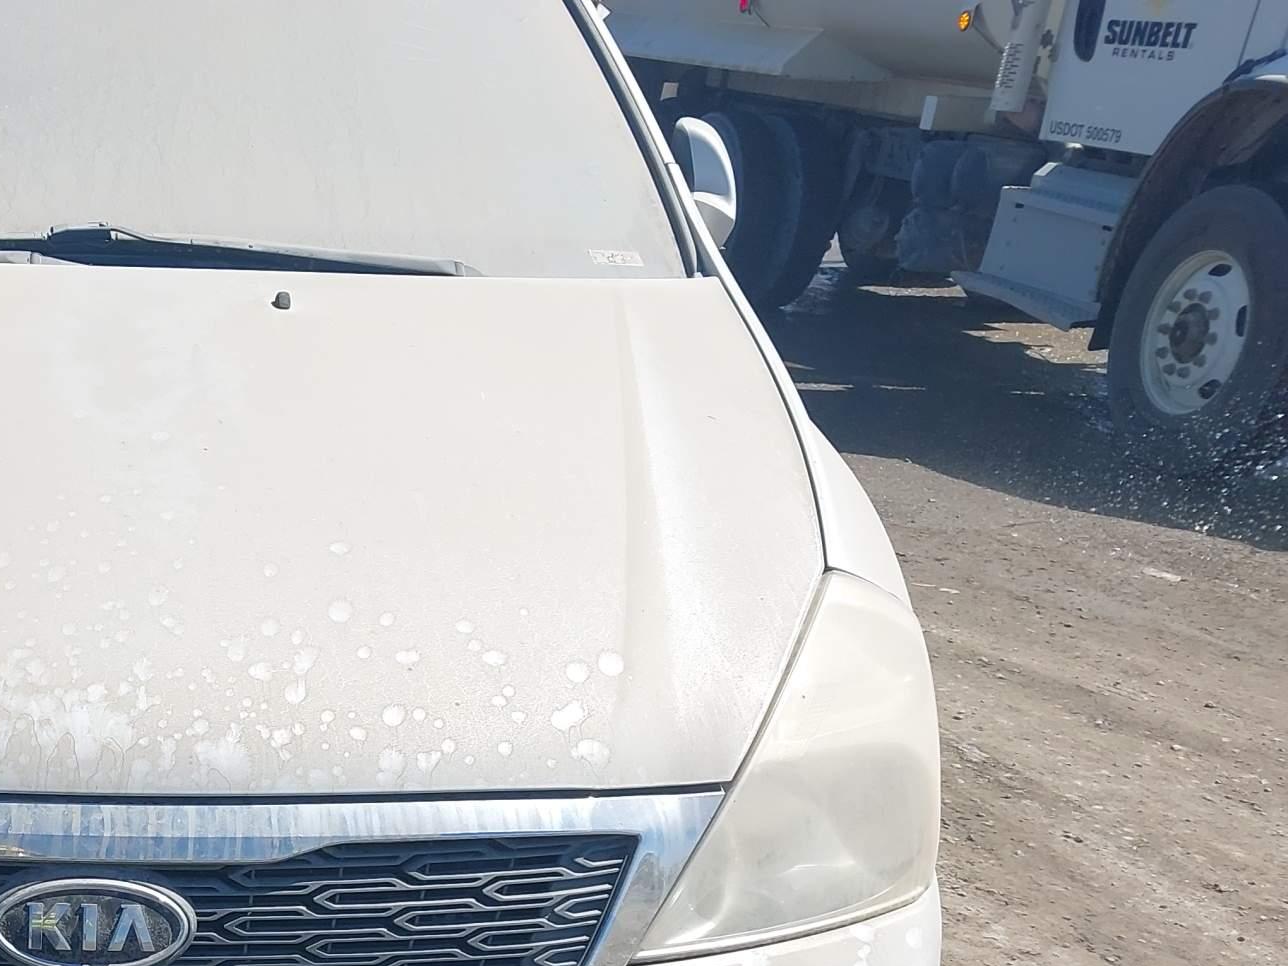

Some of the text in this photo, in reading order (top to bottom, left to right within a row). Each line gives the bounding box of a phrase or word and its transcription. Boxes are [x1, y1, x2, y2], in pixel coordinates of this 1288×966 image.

[1104, 19, 1198, 49] SUNBELT
[1112, 47, 1175, 61] RENTALS
[1049, 120, 1122, 143] USDOT 500579
[26, 902, 156, 952] KIA
